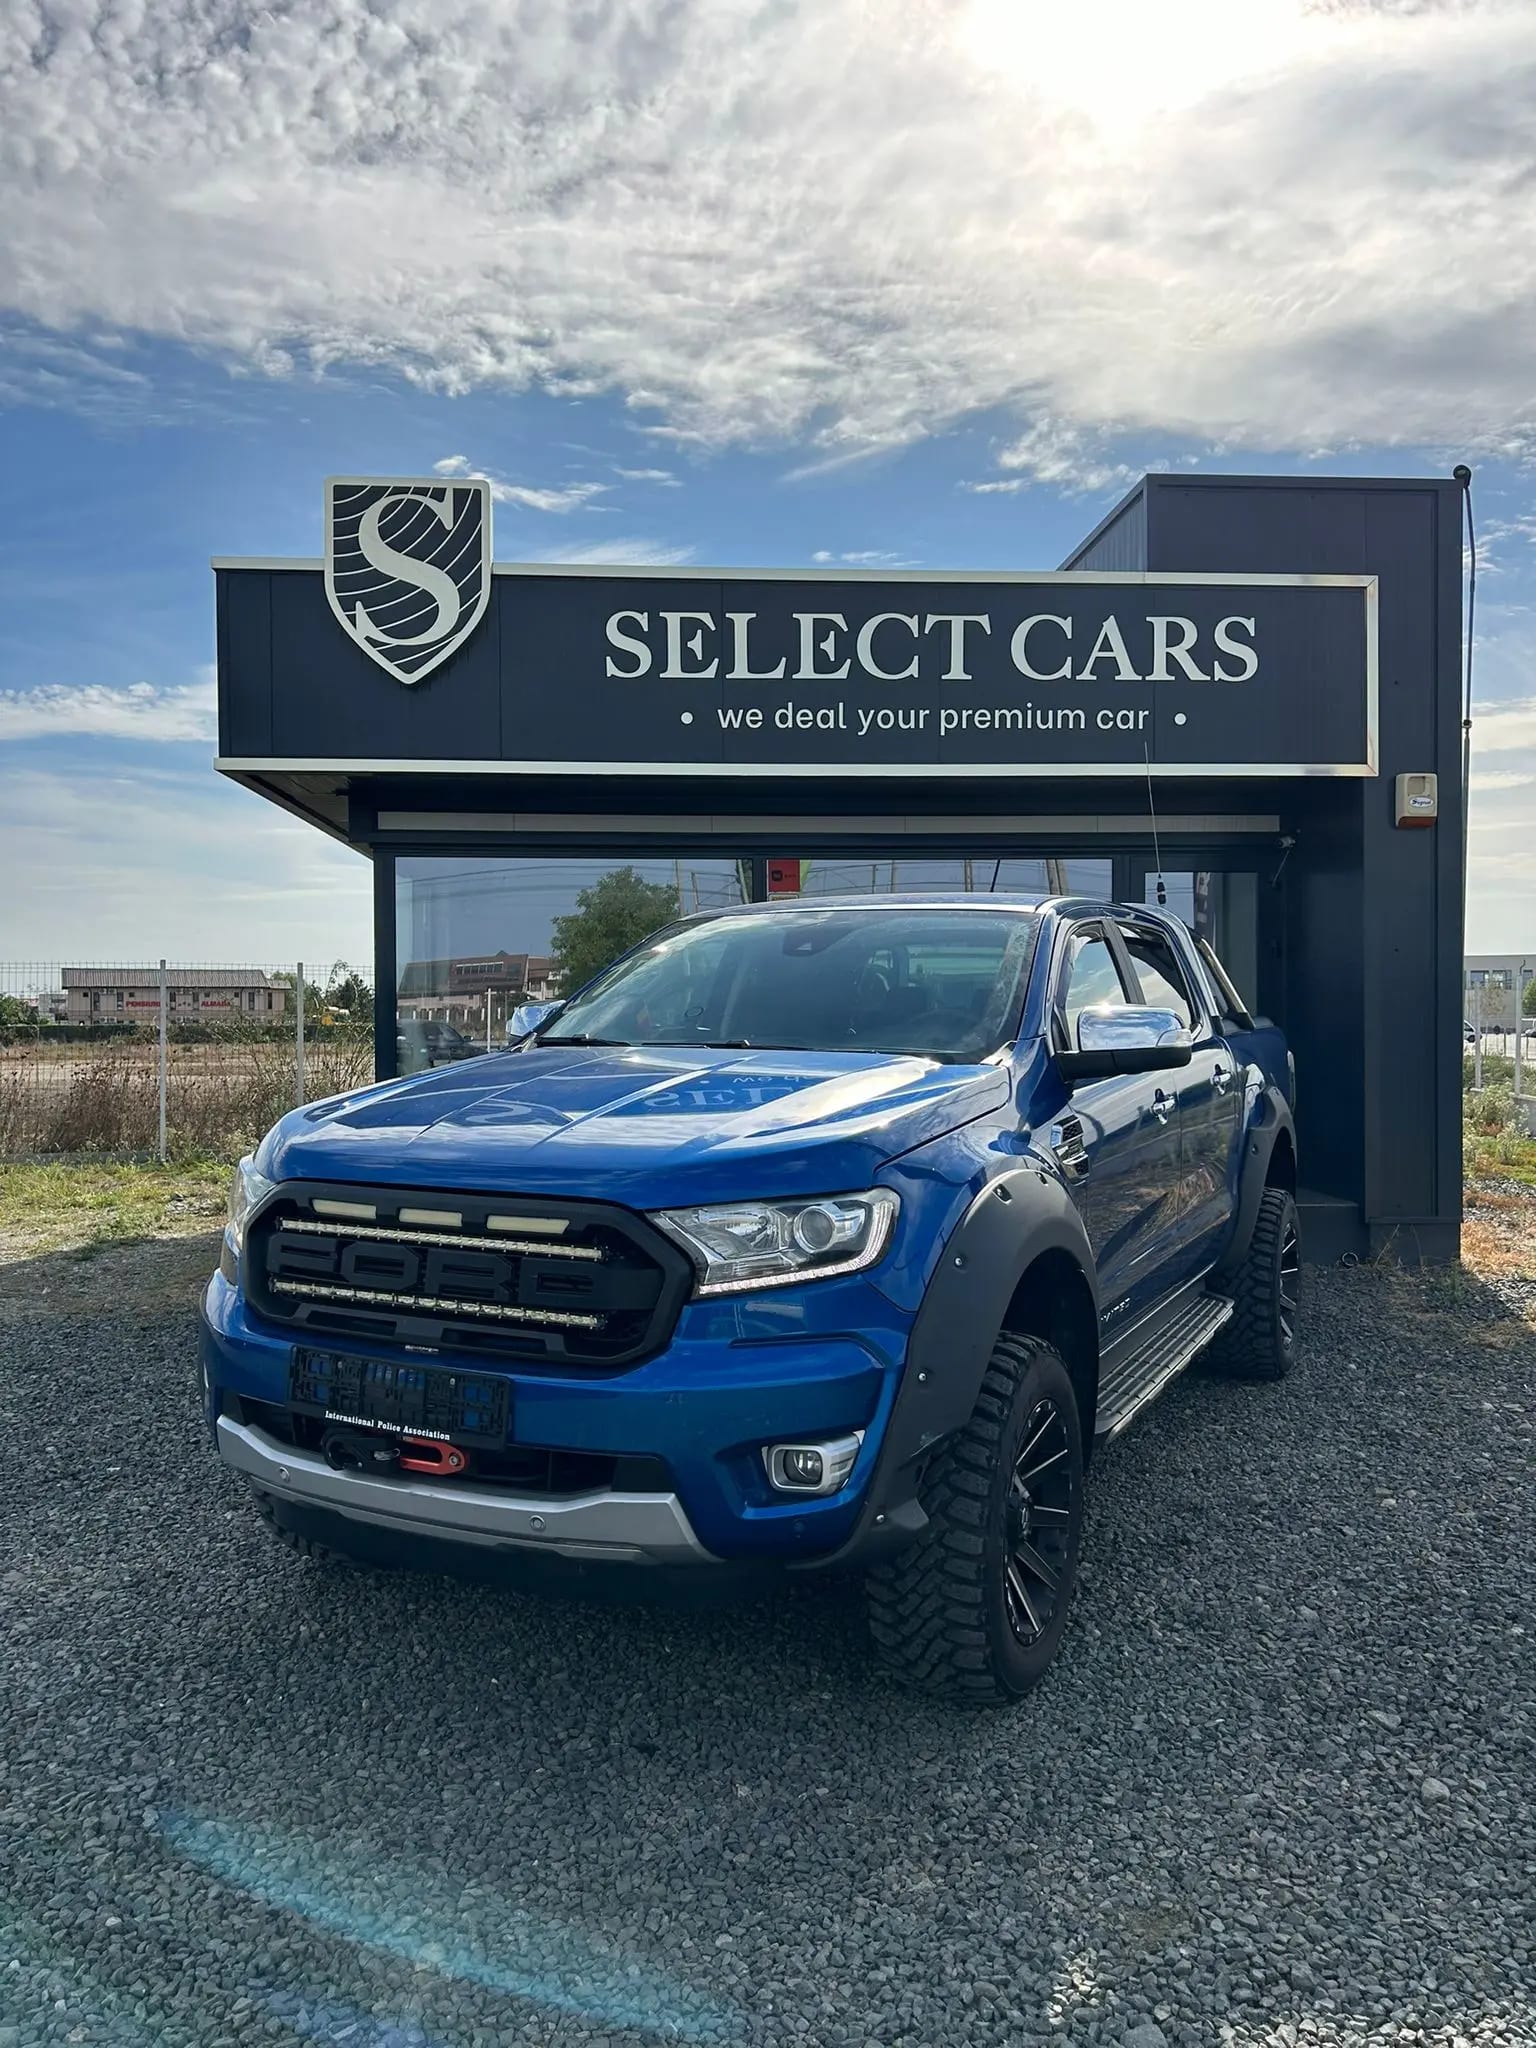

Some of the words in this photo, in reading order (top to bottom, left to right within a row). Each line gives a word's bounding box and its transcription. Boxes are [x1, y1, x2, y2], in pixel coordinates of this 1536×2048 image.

[355, 489, 460, 646] S
[606, 611, 991, 679] SELECT
[1011, 615, 1258, 681] CARS
[718, 709, 762, 728] we
[775, 702, 847, 728] deal
[858, 710, 929, 735] your
[941, 703, 1085, 735] premium
[1097, 710, 1149, 729] car
[325, 1411, 374, 1427] International
[378, 1421, 400, 1431] Police
[403, 1425, 450, 1440] Association
